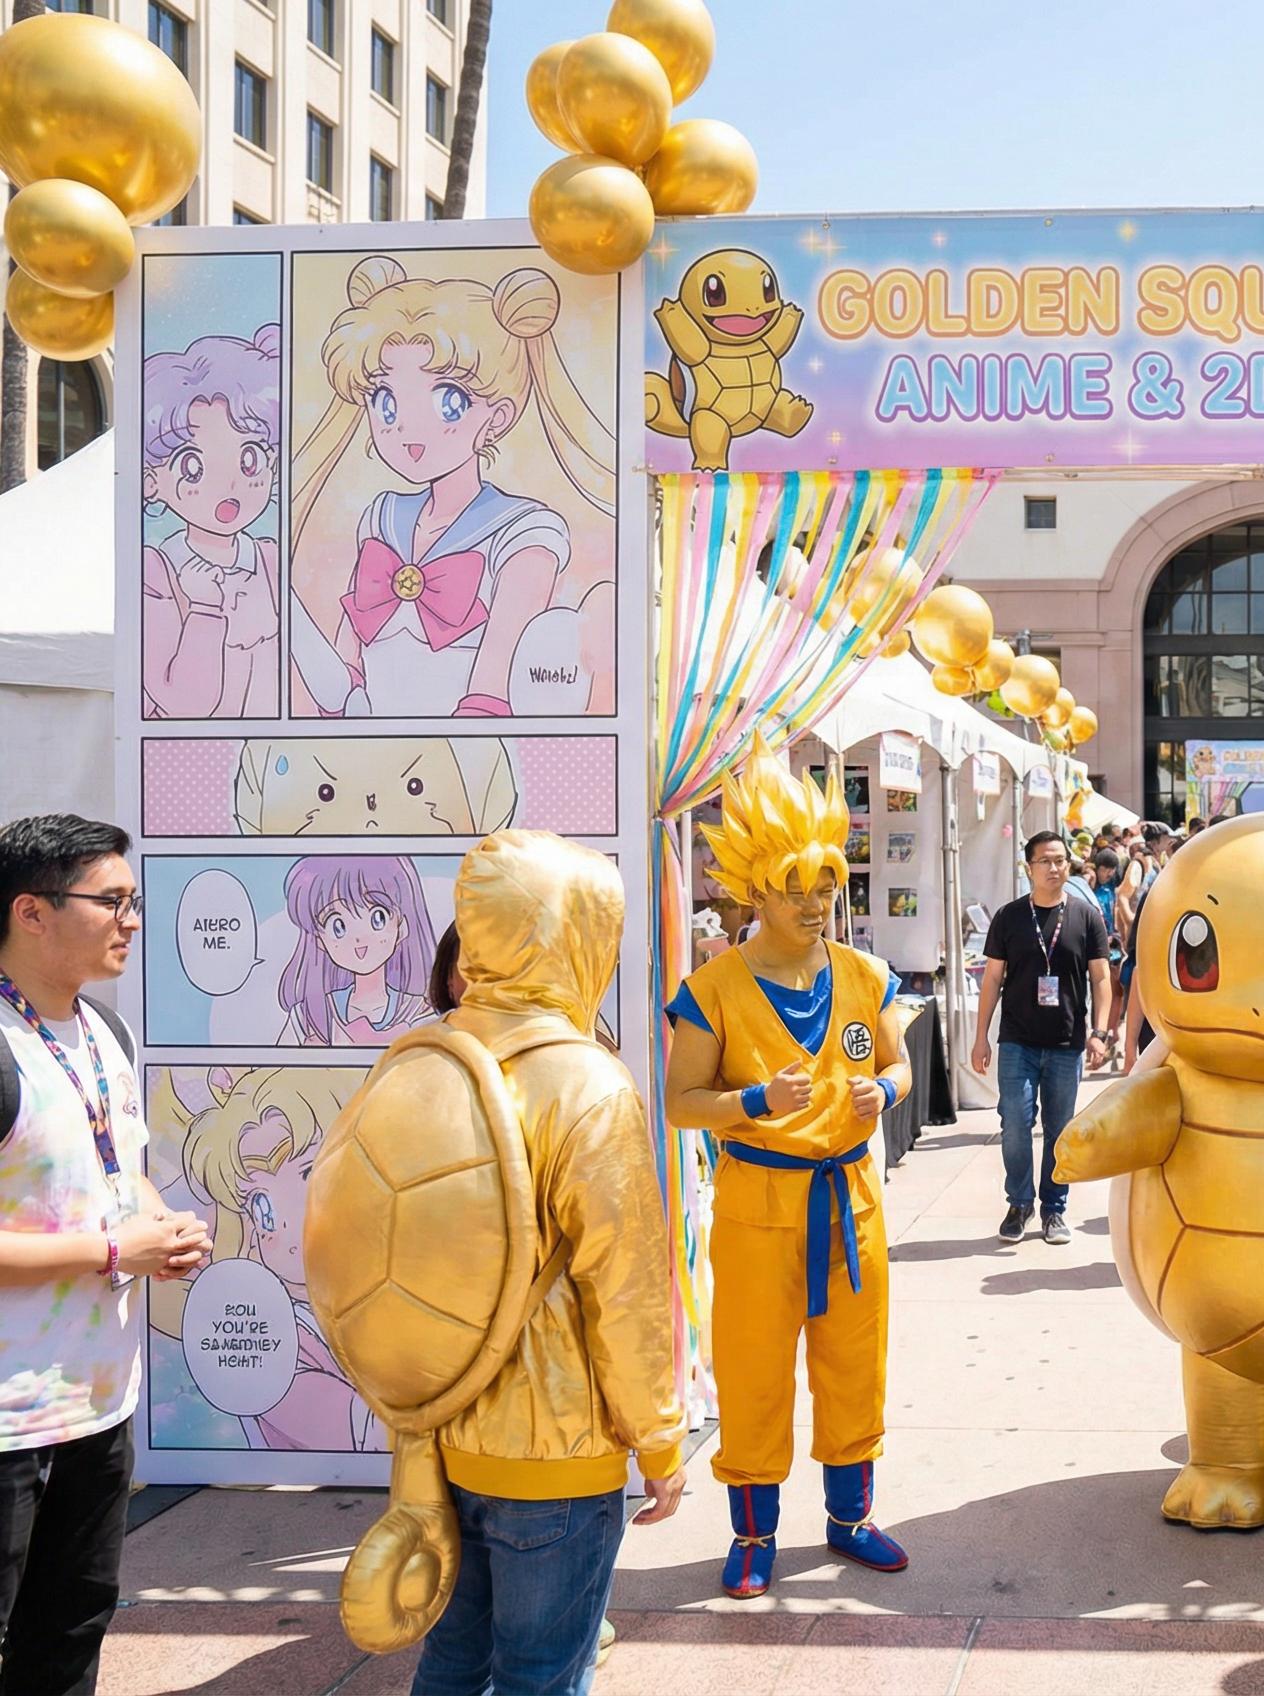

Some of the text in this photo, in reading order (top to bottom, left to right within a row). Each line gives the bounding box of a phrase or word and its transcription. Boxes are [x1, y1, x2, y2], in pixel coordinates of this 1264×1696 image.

[819, 265, 1120, 340] GOLDEN
[875, 352, 1112, 424] ANIME
[1127, 350, 1185, 421] &
[203, 936, 231, 949] ME.
[212, 1320, 269, 1334] YOU'RE
